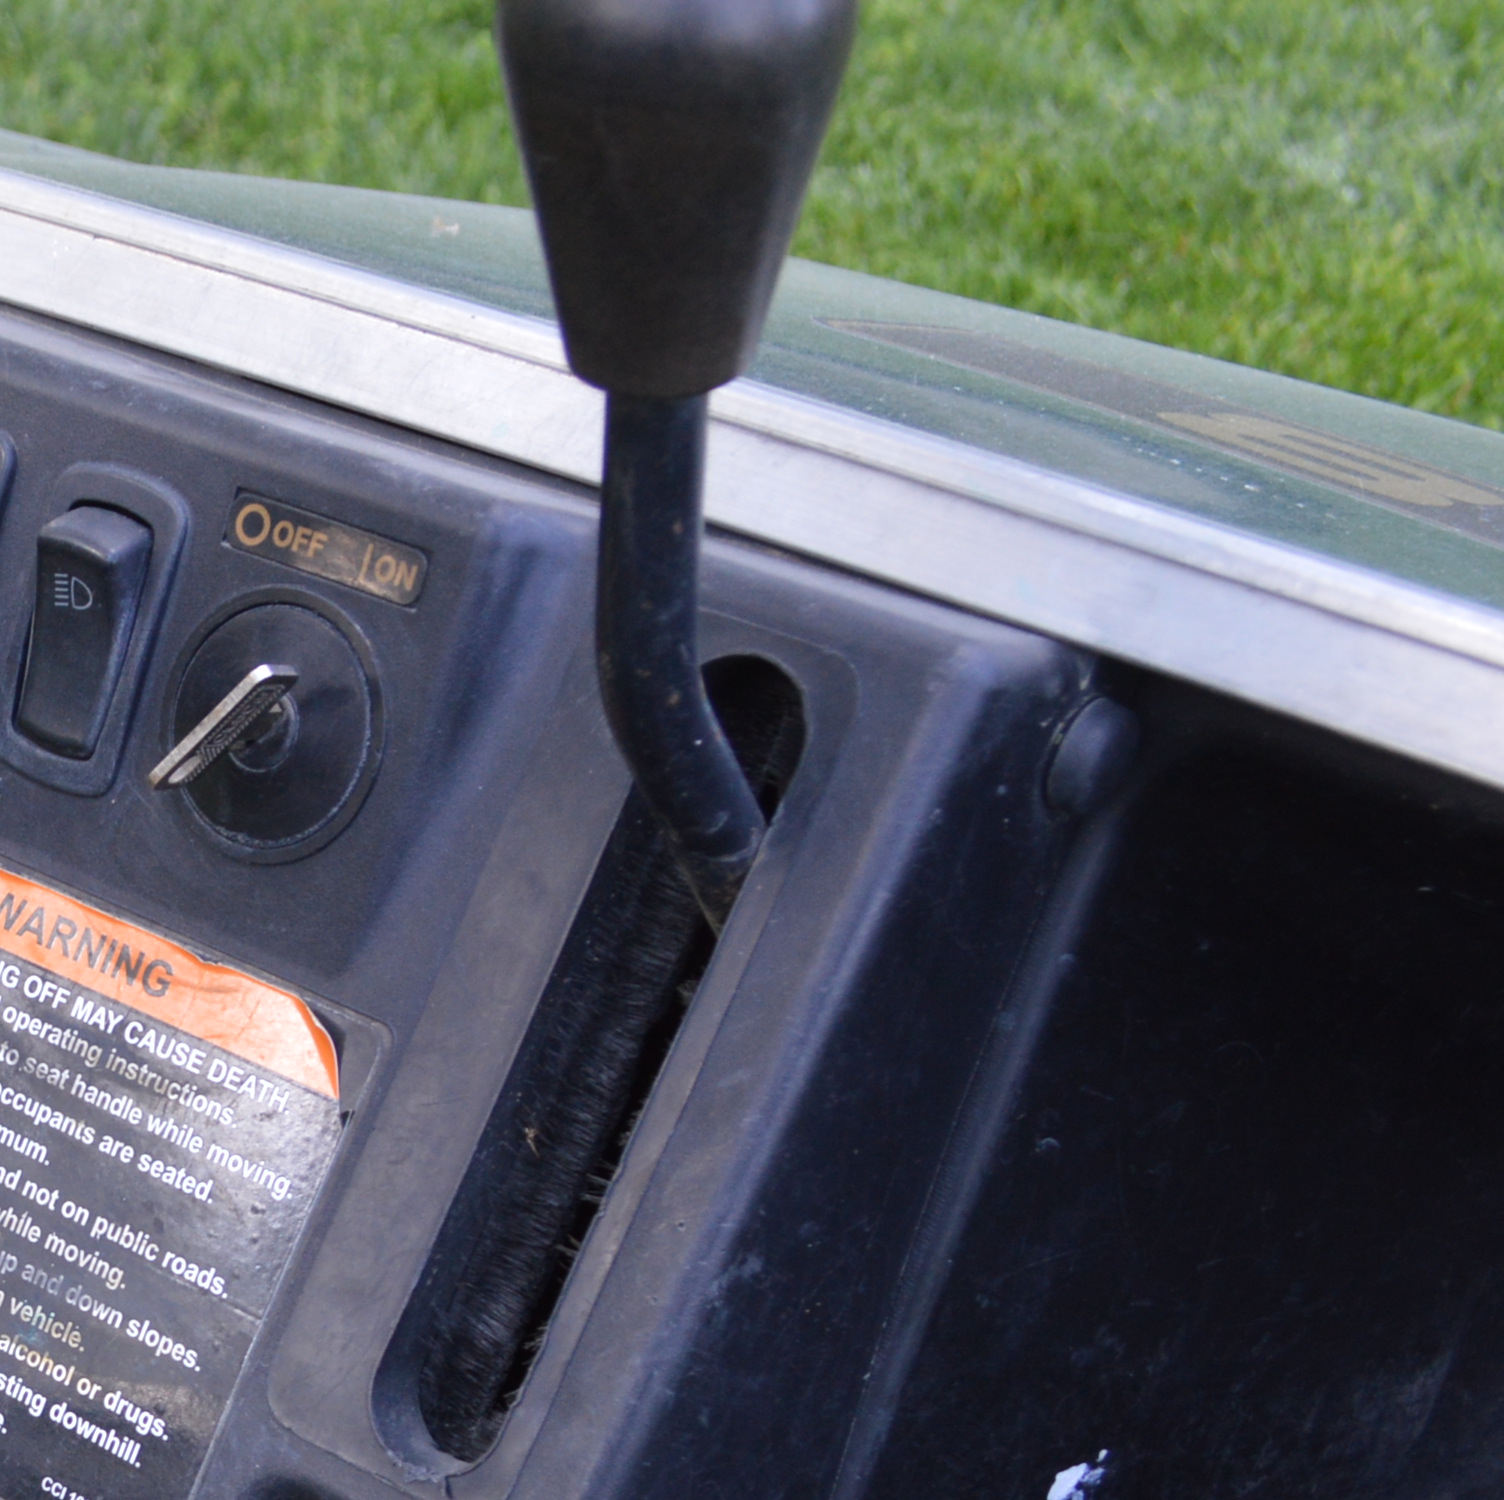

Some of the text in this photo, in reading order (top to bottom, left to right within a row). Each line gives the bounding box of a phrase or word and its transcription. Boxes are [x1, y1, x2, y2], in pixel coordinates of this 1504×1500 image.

[272, 520, 329, 558] OFF
[374, 554, 419, 592] ON
[2, 1006, 102, 1067] operating
[105, 1048, 241, 1128] instructions.
[23, 974, 70, 1008] OFF
[70, 995, 124, 1034] MAY
[123, 1020, 207, 1074] CAUSE
[207, 1058, 290, 1115] DEATH.
[18, 1056, 69, 1089] seat
[70, 1073, 142, 1124] handle
[146, 1113, 203, 1153] while
[206, 1144, 295, 1202] moving.
[98, 1135, 134, 1163] are
[136, 1153, 213, 1204] seated.
[21, 1180, 59, 1210] not
[60, 1200, 89, 1226] on
[89, 1215, 159, 1260] public
[161, 1251, 227, 1298] roads.
[43, 1231, 125, 1290] moving.
[10, 1296, 84, 1351] vehicle.
[20, 1263, 64, 1296] and
[65, 1284, 122, 1328] down
[125, 1319, 200, 1371] slopes.
[49, 1401, 140, 1467] downhill.
[76, 1377, 102, 1399] or
[103, 1390, 168, 1440] drugs.
[41, 1476, 67, 1500] CCI
